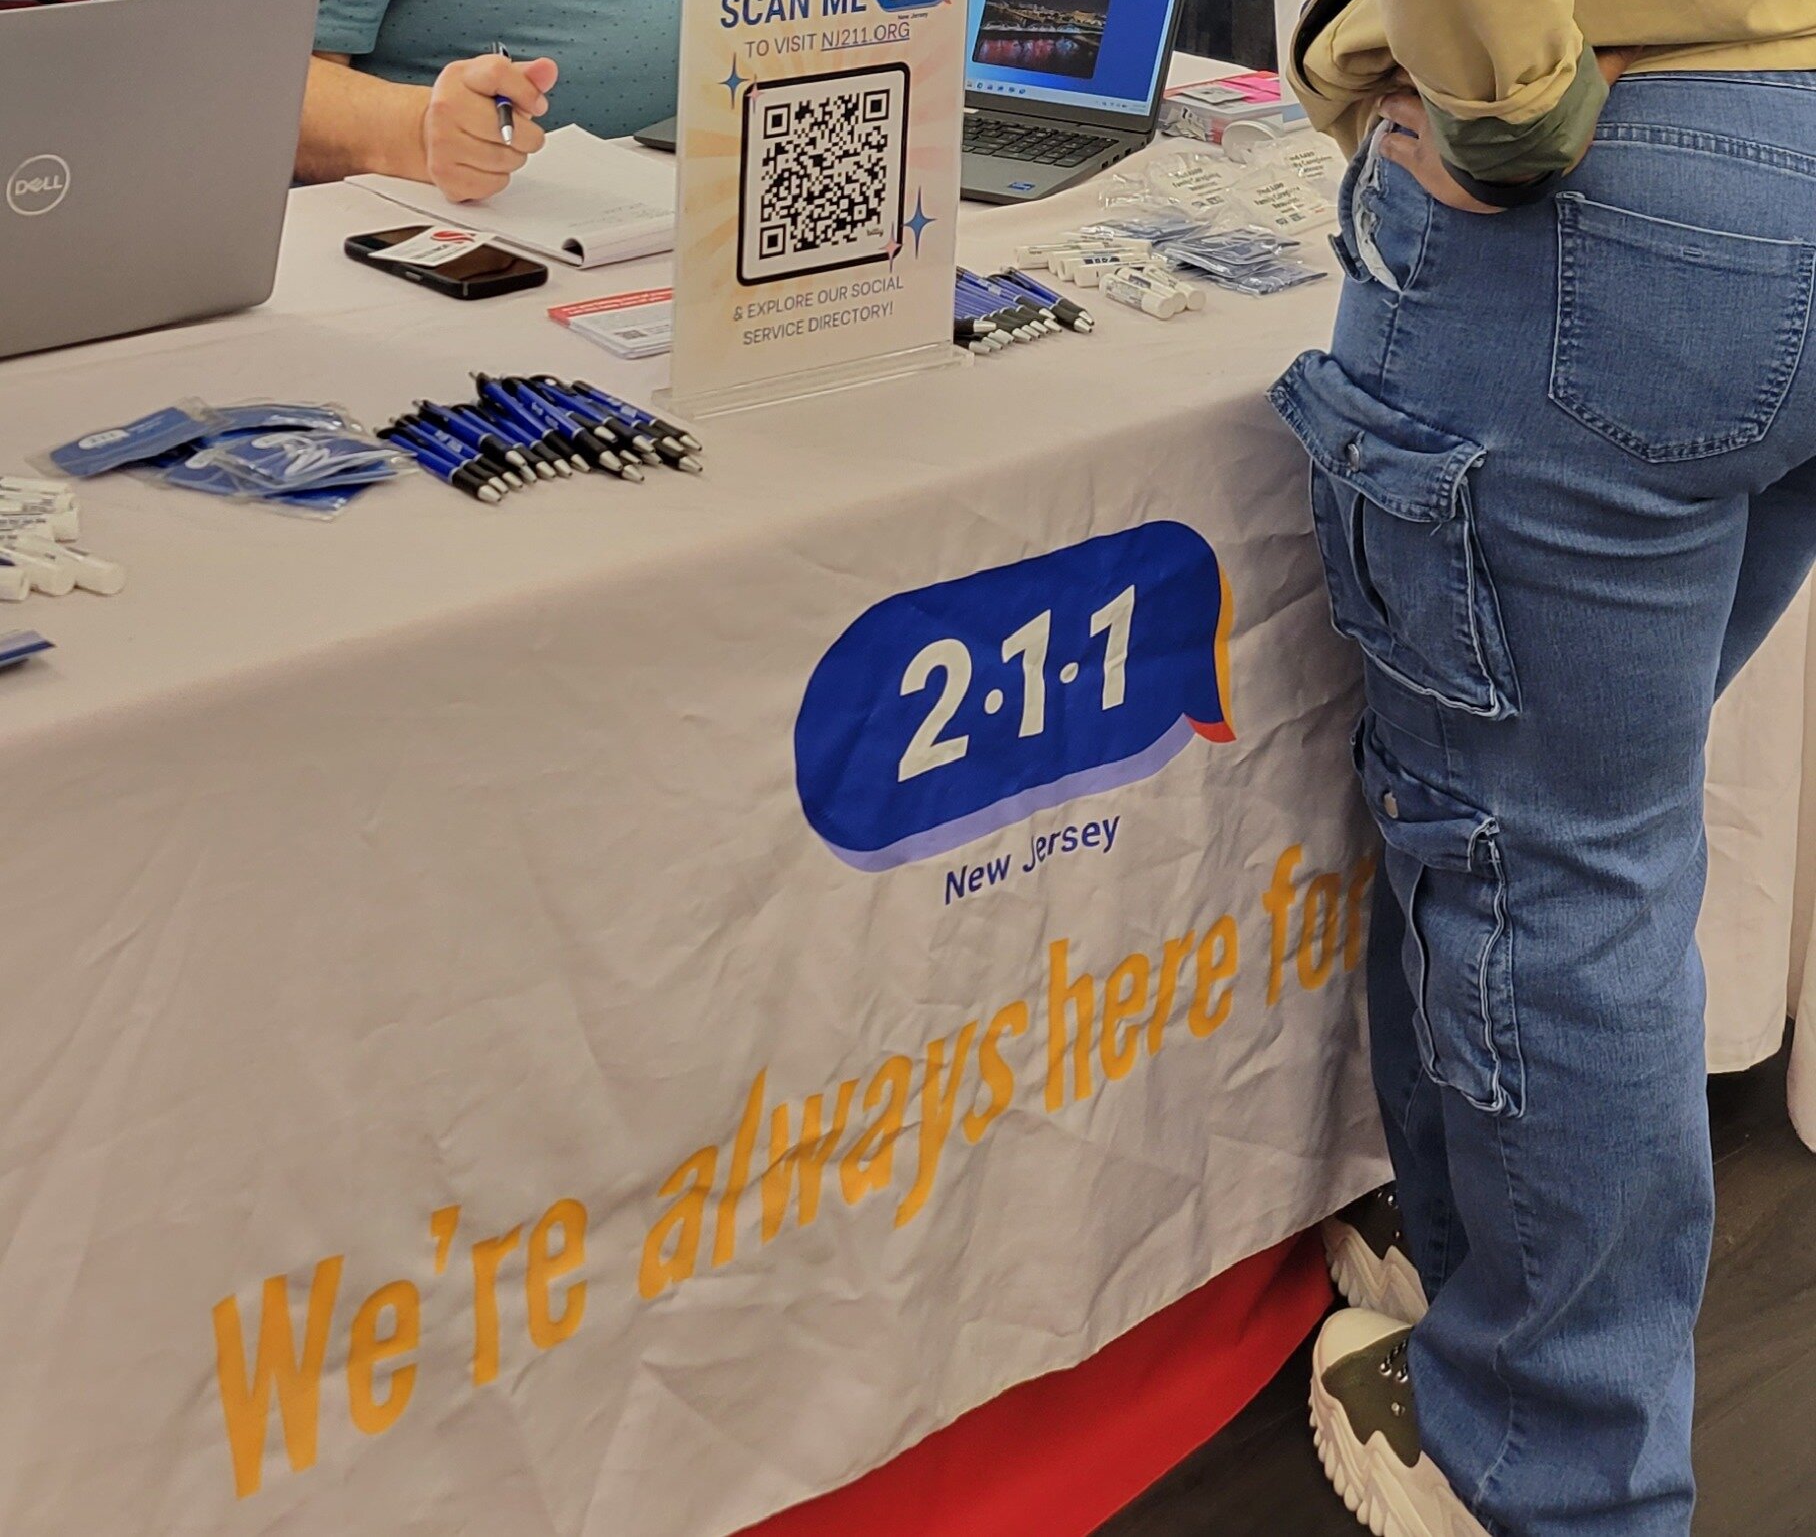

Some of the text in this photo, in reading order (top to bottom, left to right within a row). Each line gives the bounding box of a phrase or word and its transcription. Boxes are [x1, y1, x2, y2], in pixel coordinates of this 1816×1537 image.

[745, 21, 910, 58] TO VISIT NJ211.ORG
[15, 175, 63, 196] DELL
[733, 276, 904, 322] & EXPLORE OUR SOCIAL
[743, 301, 894, 345] SERVICE DIRECTORY!
[945, 815, 1121, 905] New Jersey
[212, 842, 1377, 1501] We're always here for
